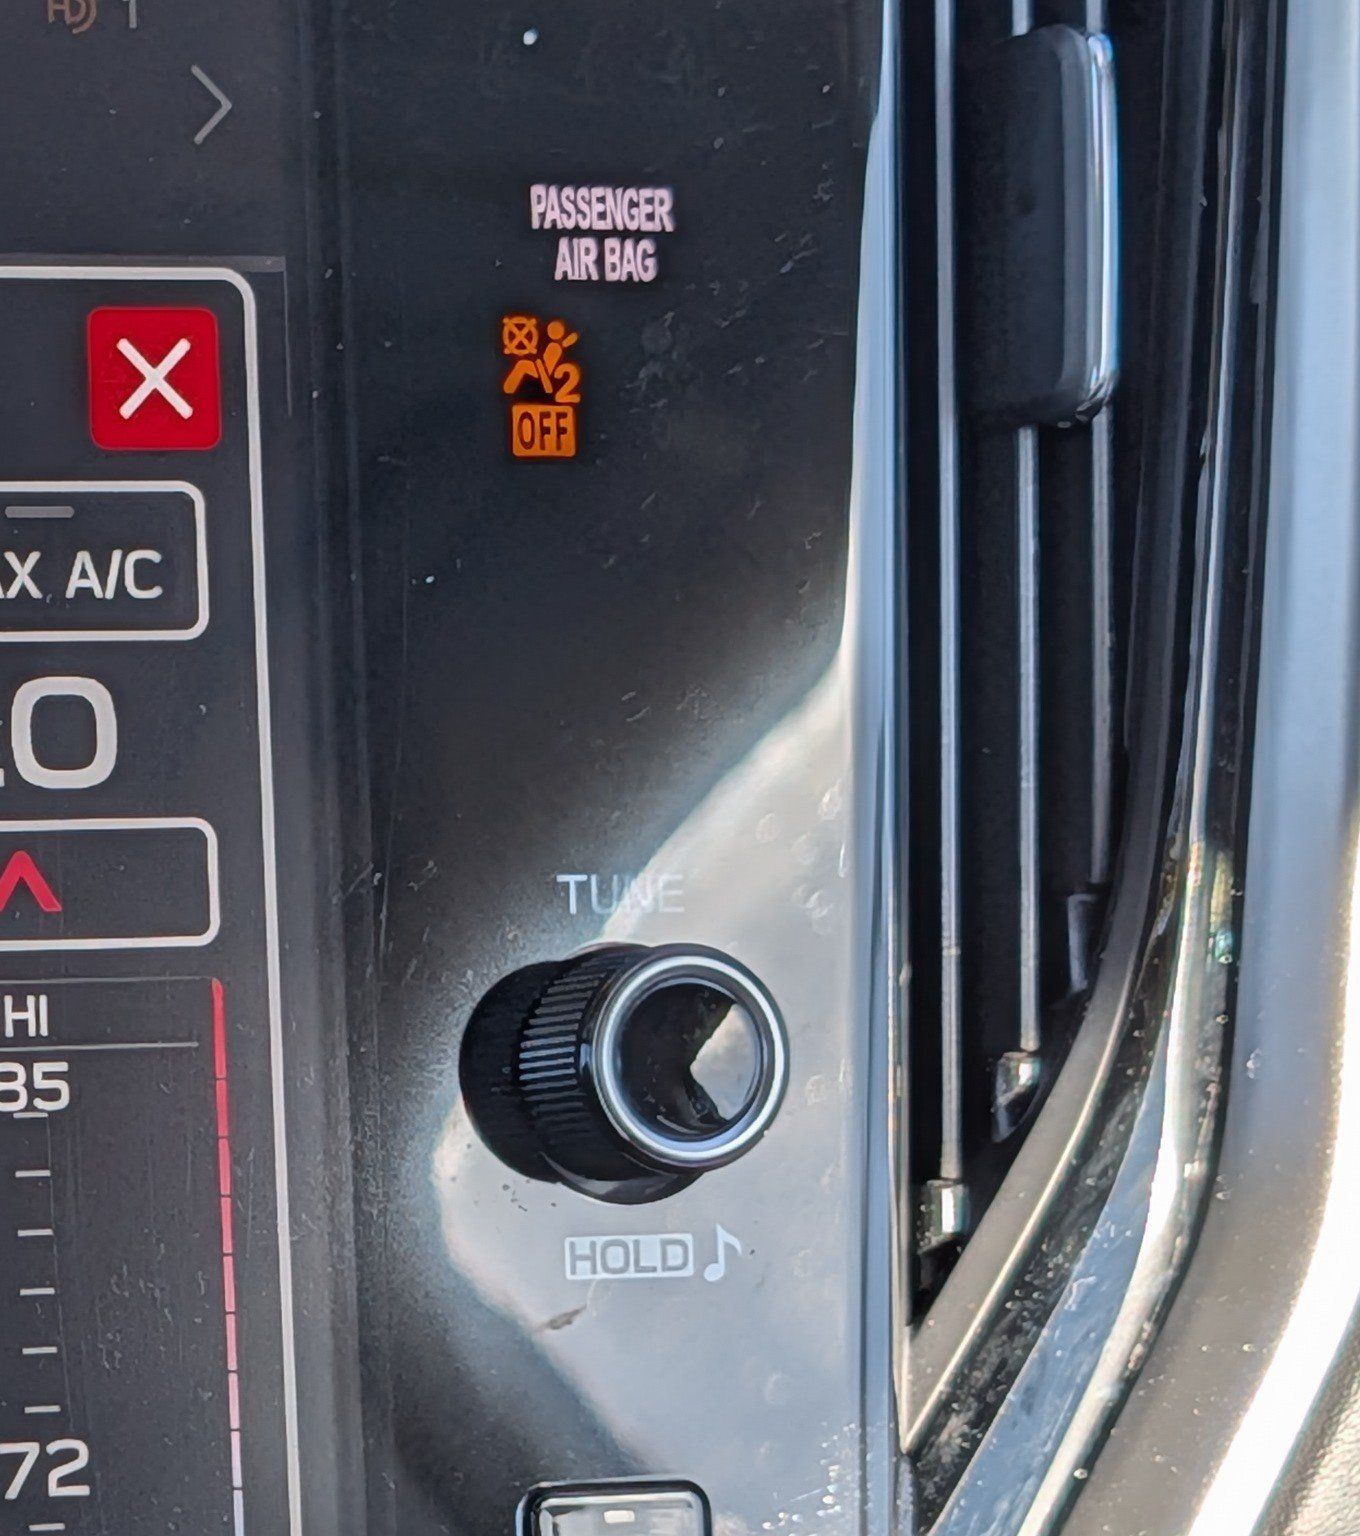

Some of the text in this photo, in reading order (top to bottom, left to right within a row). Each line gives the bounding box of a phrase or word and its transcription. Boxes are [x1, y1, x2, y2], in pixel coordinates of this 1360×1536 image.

[528, 184, 676, 233] PASSENGER
[554, 236, 659, 283] AIR BAG
[516, 410, 569, 452] OFF
[64, 547, 164, 602] A/C
[555, 872, 685, 916] TUNE
[2, 992, 50, 1038] HI
[568, 1238, 690, 1277] HOLD
